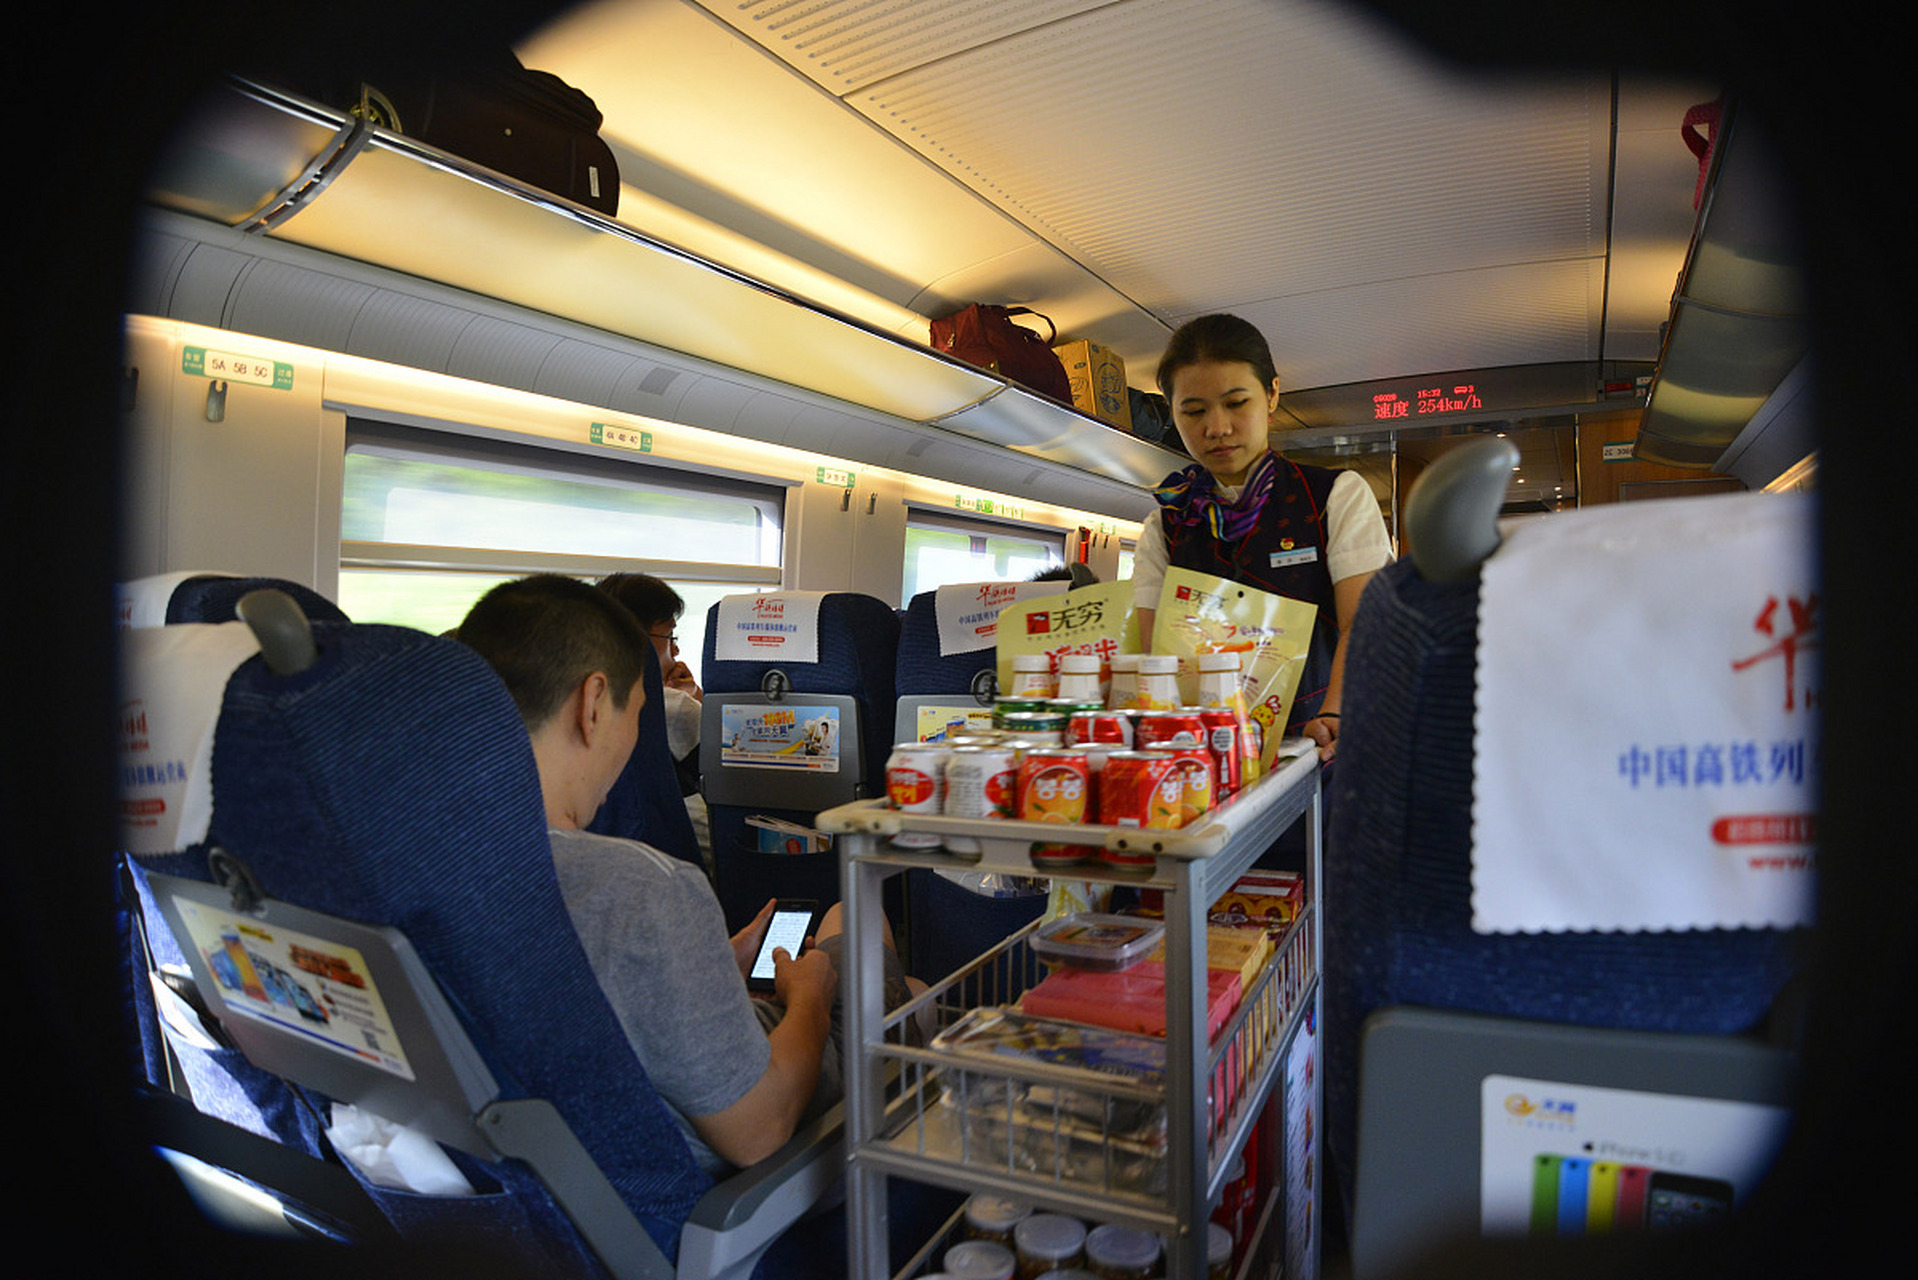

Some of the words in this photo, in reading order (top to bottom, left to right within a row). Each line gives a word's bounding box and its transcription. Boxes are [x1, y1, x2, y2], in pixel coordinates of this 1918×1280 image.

[212, 358, 226, 371] 5A
[233, 362, 247, 375] 5B
[255, 366, 268, 378] 5C
[1374, 400, 1409, 419] 速度
[1418, 394, 1482, 414] 254km/h
[1052, 601, 1104, 632] 无穷
